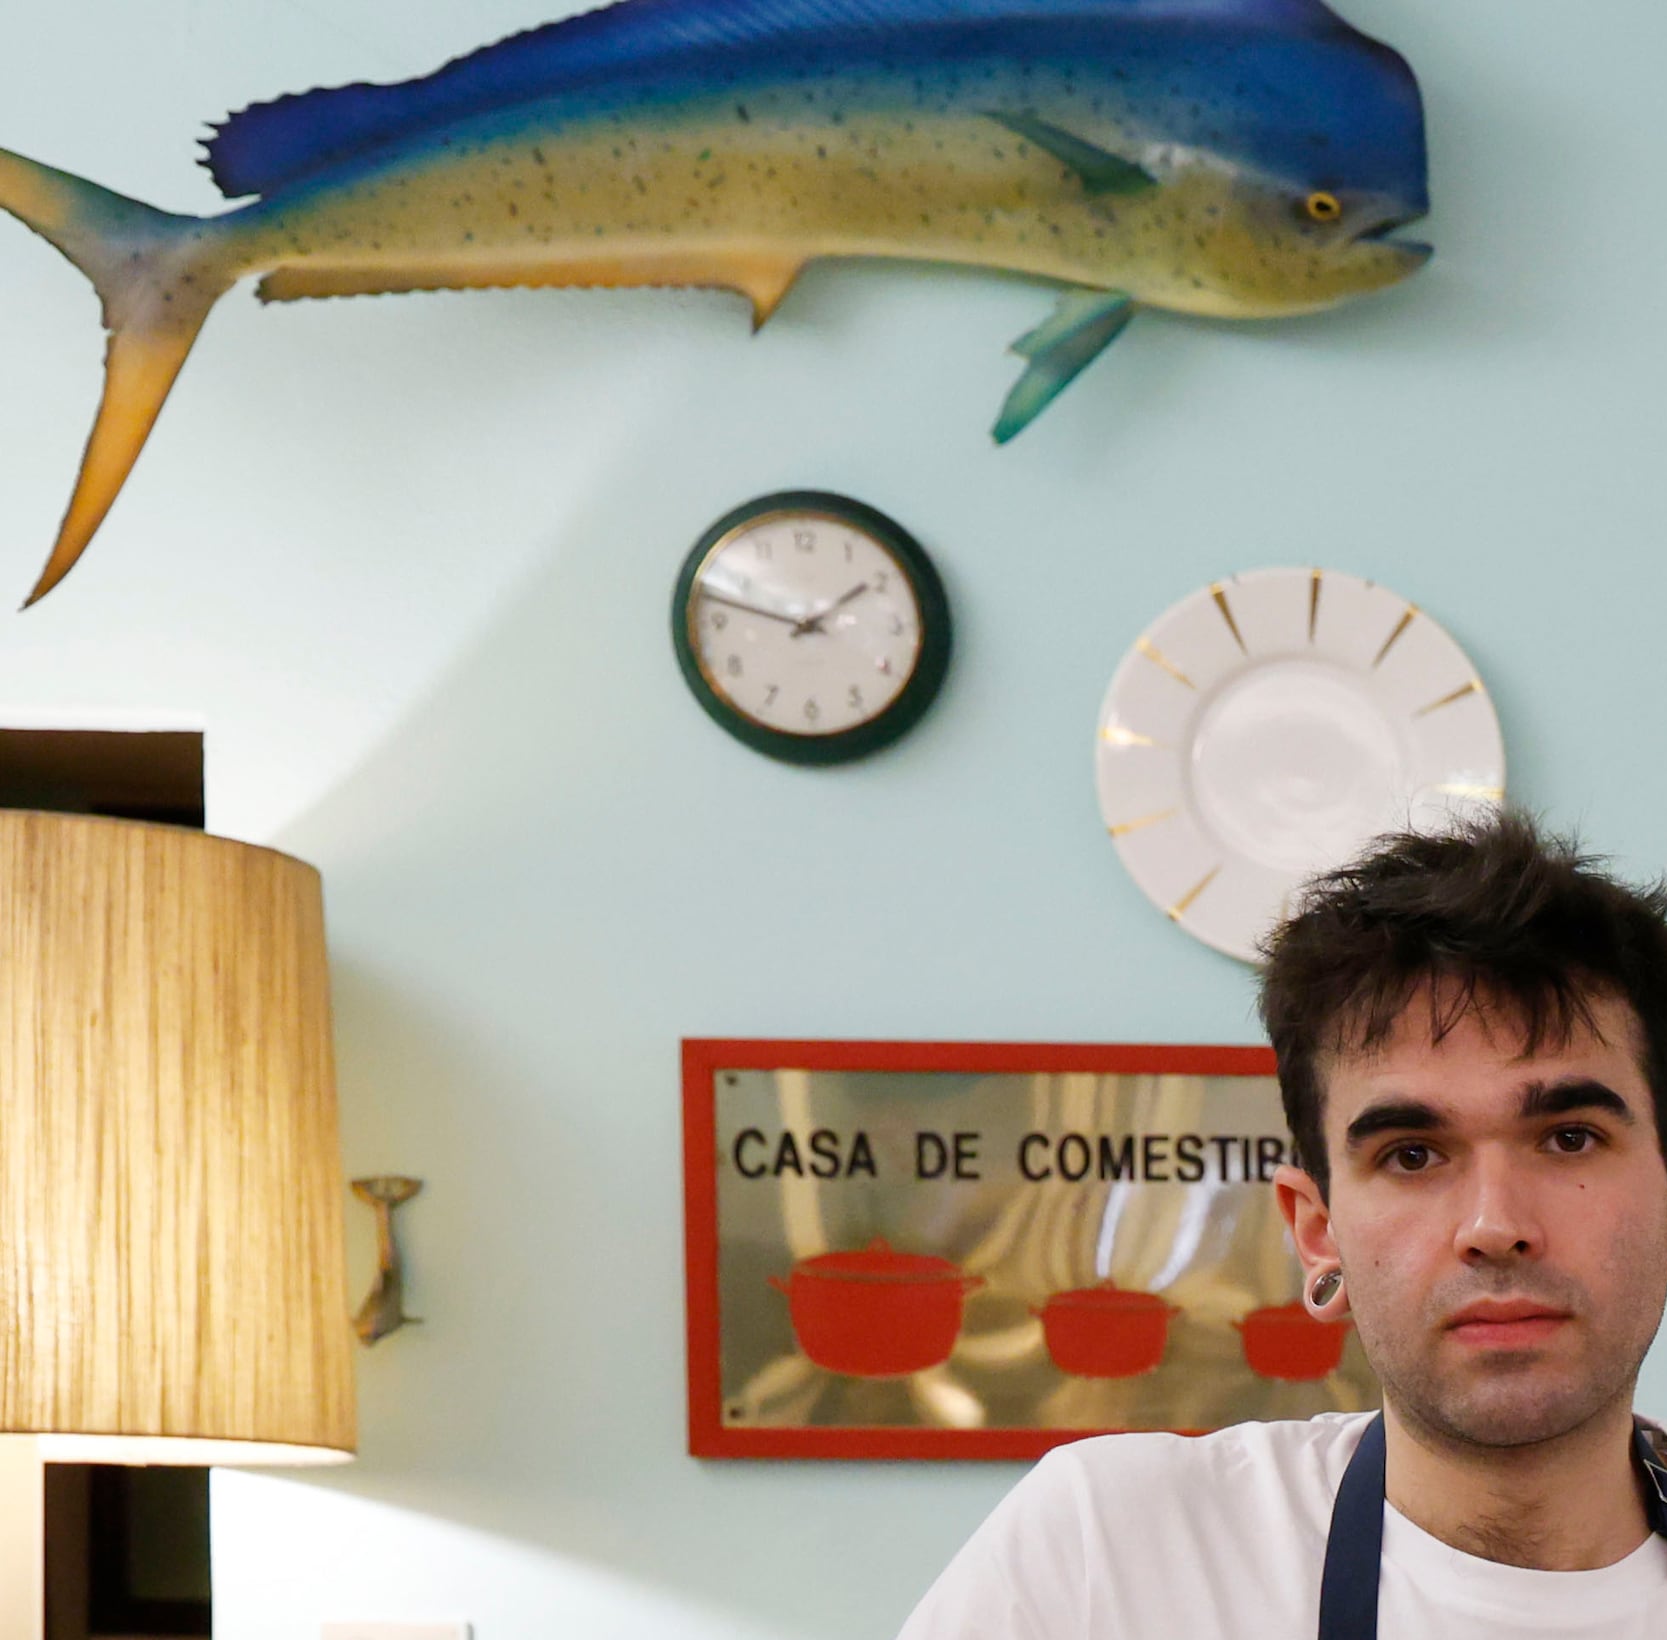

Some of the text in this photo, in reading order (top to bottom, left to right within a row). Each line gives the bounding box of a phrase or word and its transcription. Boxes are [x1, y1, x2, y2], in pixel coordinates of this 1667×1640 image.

[793, 529, 816, 554] 12
[873, 569, 889, 594] 2
[710, 610, 729, 632] 9
[726, 653, 744, 678] 8
[763, 683, 780, 707] 7
[848, 684, 864, 708] 5
[802, 697, 820, 721] 6
[732, 1128, 878, 1180] CASA
[915, 1131, 982, 1181] DE
